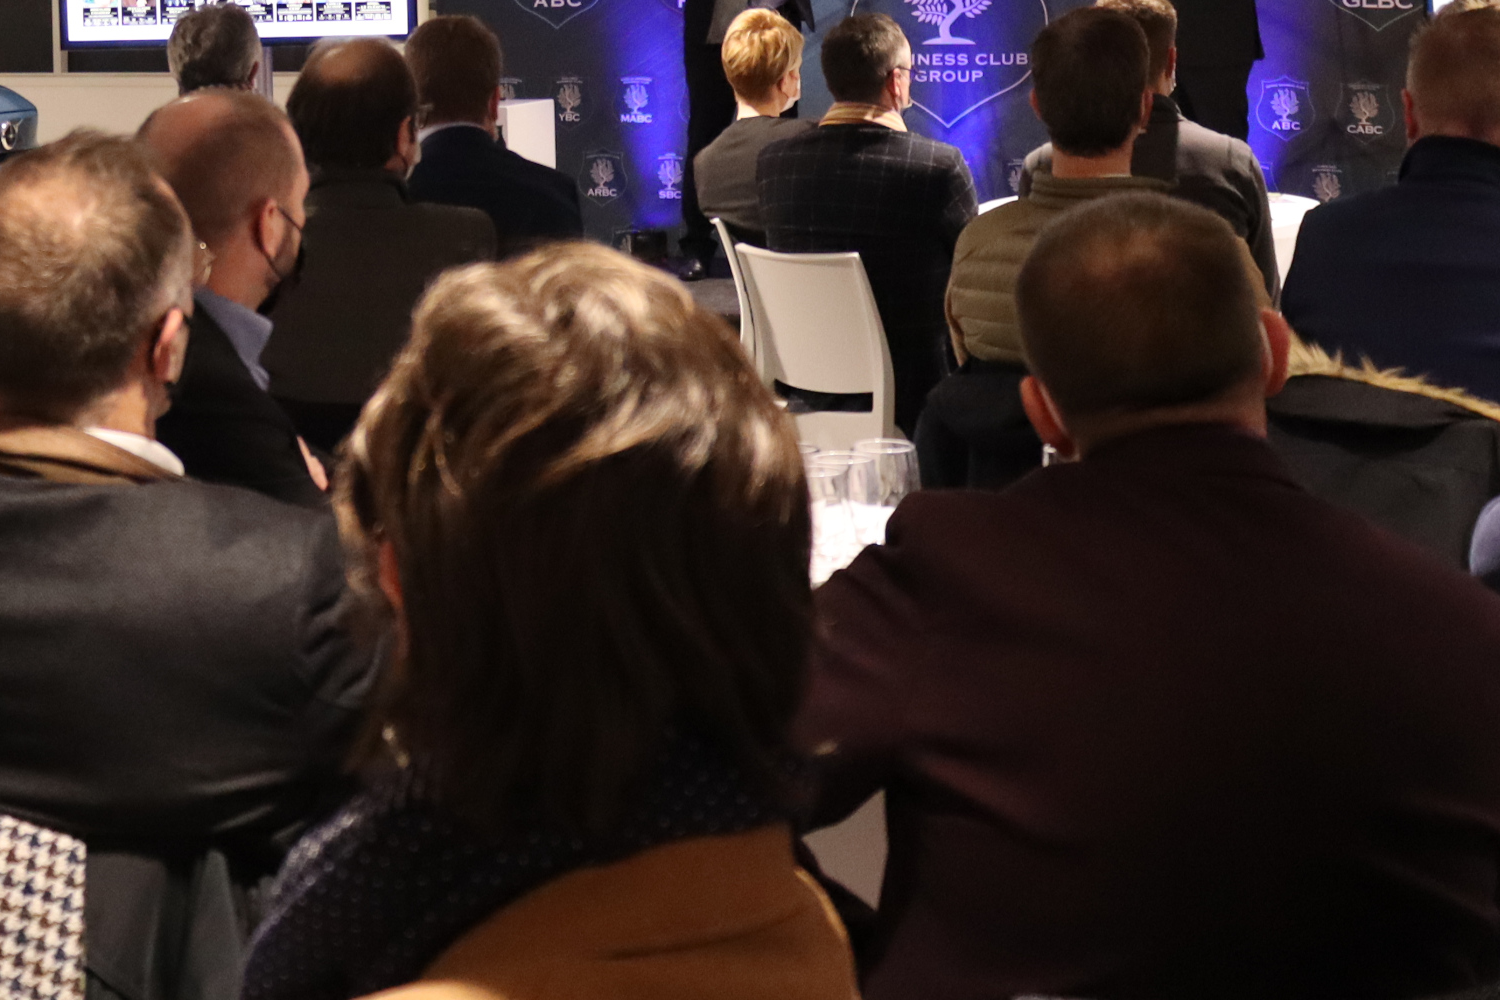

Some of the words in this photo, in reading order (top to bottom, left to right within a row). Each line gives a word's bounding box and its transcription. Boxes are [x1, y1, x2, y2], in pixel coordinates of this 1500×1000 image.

[911, 53, 969, 66] INESS
[974, 53, 1028, 66] CLUB
[914, 69, 984, 83] GROUP
[558, 113, 581, 122] YBC
[620, 114, 653, 123] MABC
[1271, 121, 1300, 131] ABC
[1346, 124, 1384, 135] CABC
[587, 188, 617, 197] ARBC
[658, 190, 682, 199] SBC
